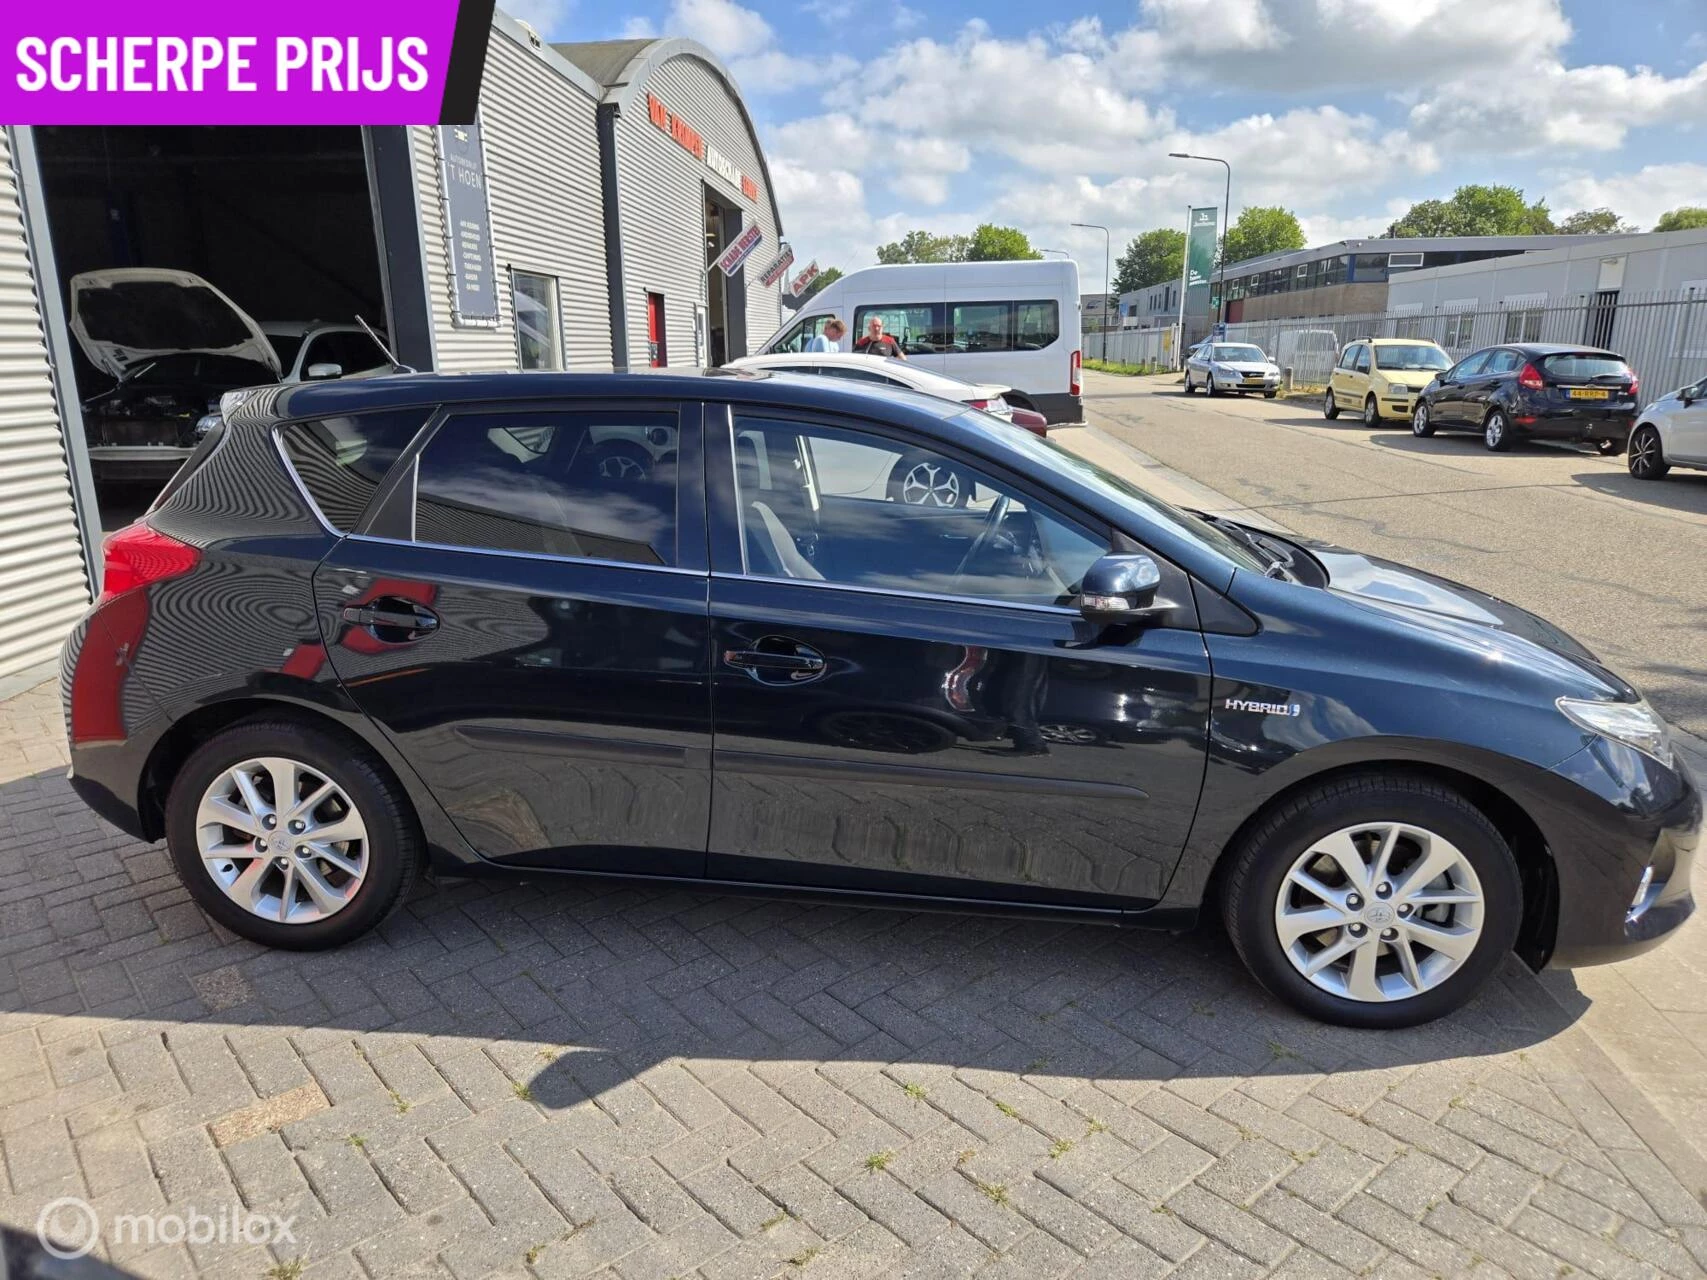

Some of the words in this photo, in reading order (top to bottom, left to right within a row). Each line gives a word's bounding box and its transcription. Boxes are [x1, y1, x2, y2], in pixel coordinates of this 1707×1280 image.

[648, 93, 667, 131] VAN
[720, 246, 742, 271] SCHADE
[793, 263, 818, 293] APK
[1225, 699, 1290, 716] HYBRID
